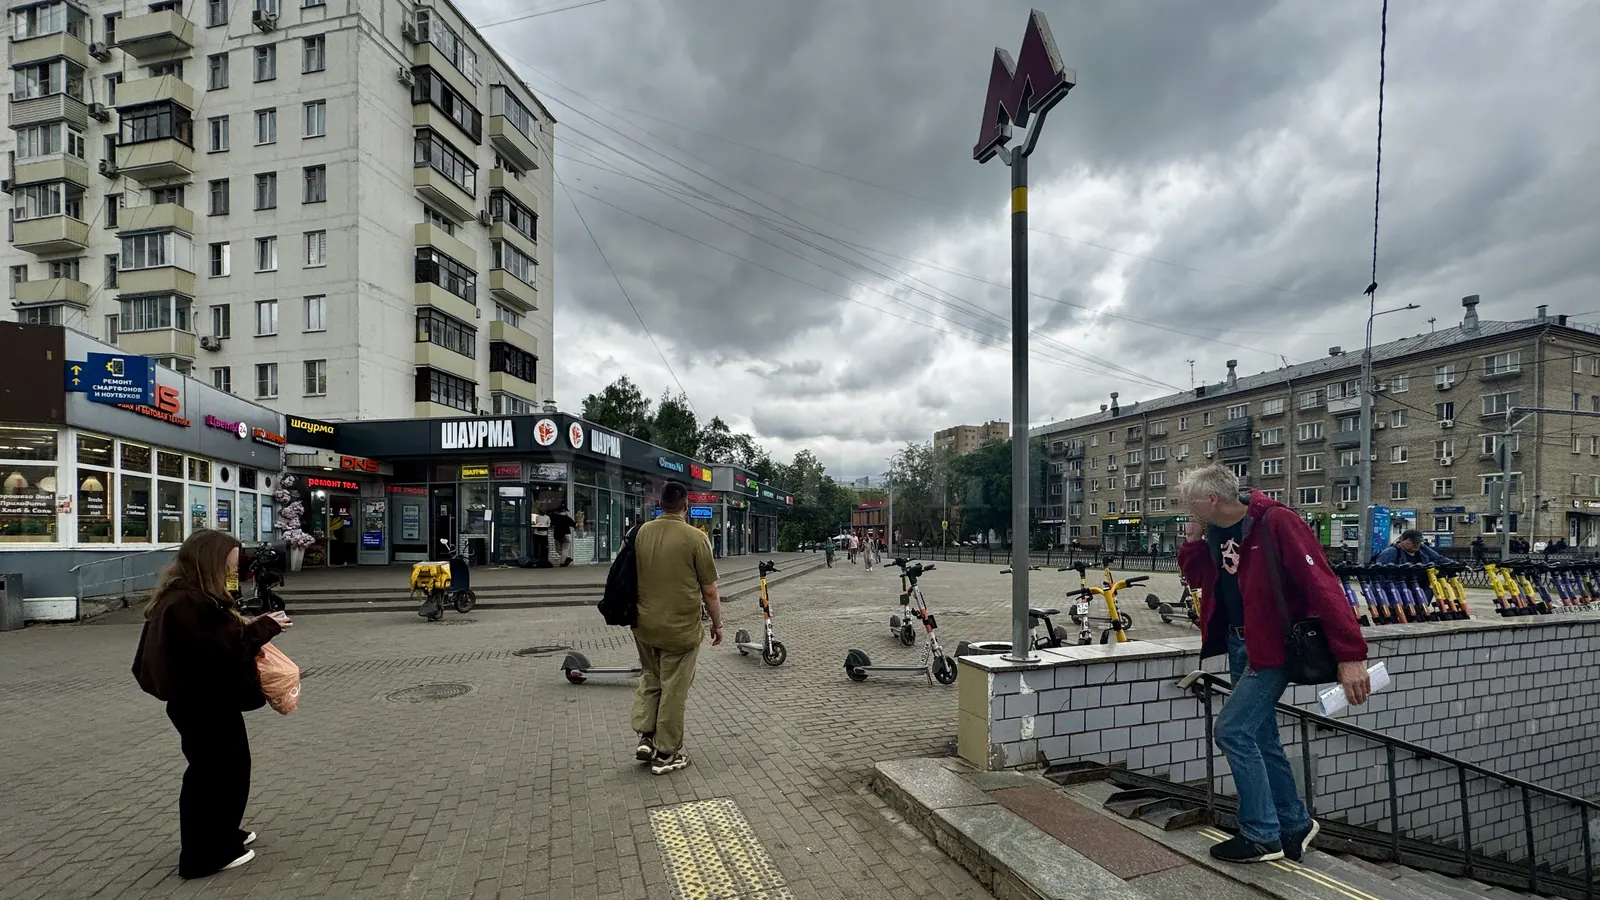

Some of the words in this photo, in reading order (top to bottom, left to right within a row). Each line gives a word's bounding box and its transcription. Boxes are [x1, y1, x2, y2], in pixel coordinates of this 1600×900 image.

[92, 385, 143, 393] СМАРТФОНОВ
[141, 407, 168, 420] БЫТОВАЯ
[169, 414, 193, 428] ТЕХНИКА
[208, 414, 238, 433] Цветы
[291, 418, 335, 434] шаурма
[441, 419, 514, 449] ШАУРМА
[591, 429, 621, 459] ШАУРМА
[341, 456, 380, 472] DNS
[308, 478, 341, 488] ремонт
[342, 481, 359, 490] тел.
